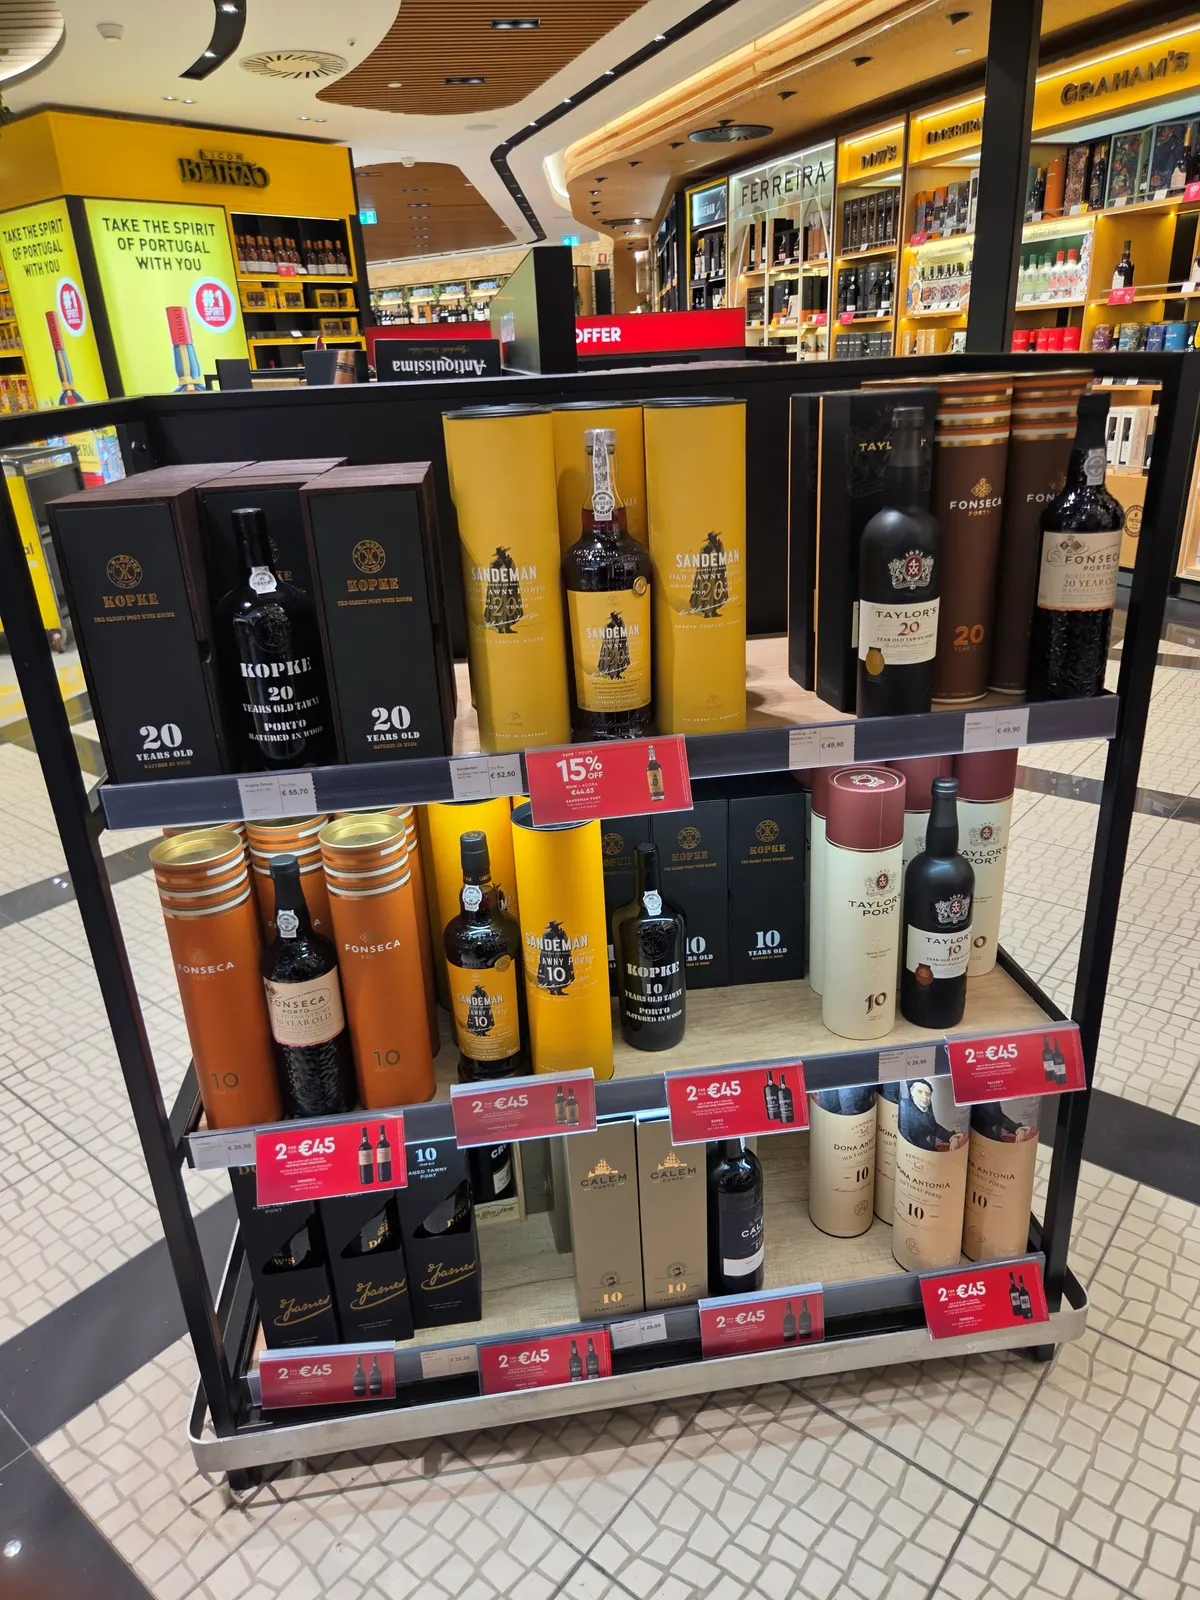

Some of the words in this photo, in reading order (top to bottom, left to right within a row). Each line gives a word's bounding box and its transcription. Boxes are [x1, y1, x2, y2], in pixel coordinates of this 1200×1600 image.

[1060, 51, 1190, 107] GRAHAM'S
[203, 151, 244, 162] LICOR
[861, 145, 897, 171] DOW'S
[178, 158, 270, 188] BEIRÃO
[741, 160, 828, 207] FERREIRA
[3, 227, 23, 245] TAKE
[23, 223, 38, 241] THE
[39, 218, 64, 239] SPIRIT
[102, 217, 140, 232] TAKE
[143, 220, 171, 234] THE
[174, 222, 215, 236] SPIRIT
[12, 249, 22, 261] OF
[23, 239, 63, 258] PORTUGAL
[117, 237, 135, 251] OF
[139, 239, 212, 254] PORTUGAL
[24, 262, 45, 278] WITH
[45, 259, 61, 274] YOU
[136, 257, 173, 271] WITH
[176, 259, 202, 272] YOU
[203, 290, 223, 307] #1
[575, 327, 621, 344] OFFER
[393, 356, 487, 376] Antiquissima
[949, 496, 1003, 510] FONSECA
[676, 549, 739, 568] SANDEMAN
[1065, 553, 1121, 565] FONSEC
[471, 566, 537, 583] SANDEMAN
[347, 577, 399, 592] KOPKE
[701, 580, 724, 601] 20
[102, 593, 159, 608] KOPKE
[492, 597, 517, 617] 20
[876, 607, 936, 619] TAYLOR'S
[586, 624, 640, 640] SANDEMAN
[897, 621, 920, 637] 20
[953, 624, 985, 646] 20
[240, 657, 312, 679] KOPKE
[268, 685, 294, 701] 20
[243, 703, 272, 714] YEARS
[273, 702, 294, 714] OLD
[264, 719, 307, 732] PORTO
[371, 705, 411, 731] 20
[139, 723, 183, 750] 20
[291, 731, 303, 742] IN
[366, 732, 398, 742] YEARS
[401, 730, 420, 740] OLD
[136, 751, 170, 762] YEARS
[173, 749, 194, 759] OLD
[490, 772, 496, 780] €
[556, 756, 603, 782] 15%
[587, 771, 604, 779] OFF
[282, 789, 287, 797] €
[750, 844, 786, 856] KOPKE
[862, 904, 895, 917] PORT
[345, 939, 401, 954] FONSECA
[526, 932, 588, 952] SANDEMAN
[686, 937, 706, 954] 10
[756, 929, 781, 948] 10
[926, 933, 970, 945] TAYLOR
[699, 953, 714, 962] OLD
[748, 948, 772, 958] YEARS
[774, 947, 788, 955] OLD
[947, 944, 961, 958] 10
[177, 961, 235, 974] FONSECA
[547, 966, 567, 982] 10
[627, 961, 680, 978] KOPKE
[625, 989, 646, 1002] YEARS
[646, 983, 663, 995] 10
[269, 996, 325, 1008] FONSECA
[865, 992, 887, 1015] 10
[639, 1007, 670, 1015] PORTO
[475, 1016, 495, 1028] 10
[373, 1049, 401, 1067] 10
[965, 1048, 976, 1064] 2
[985, 1043, 1018, 1061] €45
[210, 1072, 240, 1090] 10
[687, 1086, 698, 1101] 2
[707, 1081, 742, 1098] €45
[472, 1100, 484, 1113] 2
[494, 1094, 529, 1110] €45
[275, 1143, 287, 1160] 2
[298, 1137, 336, 1156] €45
[415, 1147, 437, 1162] 10
[834, 1143, 858, 1152] DONA
[856, 1166, 869, 1182] 10
[977, 1166, 1016, 1180] ANTONIA
[912, 1178, 951, 1190] ANTONIA
[972, 1191, 988, 1209] 10
[908, 1203, 925, 1220] 10
[668, 1282, 687, 1294] 10
[938, 1288, 948, 1302] 2
[956, 1281, 986, 1299] €45
[602, 1292, 623, 1304] 10
[716, 1315, 726, 1328] 2
[735, 1310, 766, 1325] €45
[498, 1354, 508, 1368] 2
[518, 1348, 550, 1365] €45
[278, 1367, 288, 1379] 2
